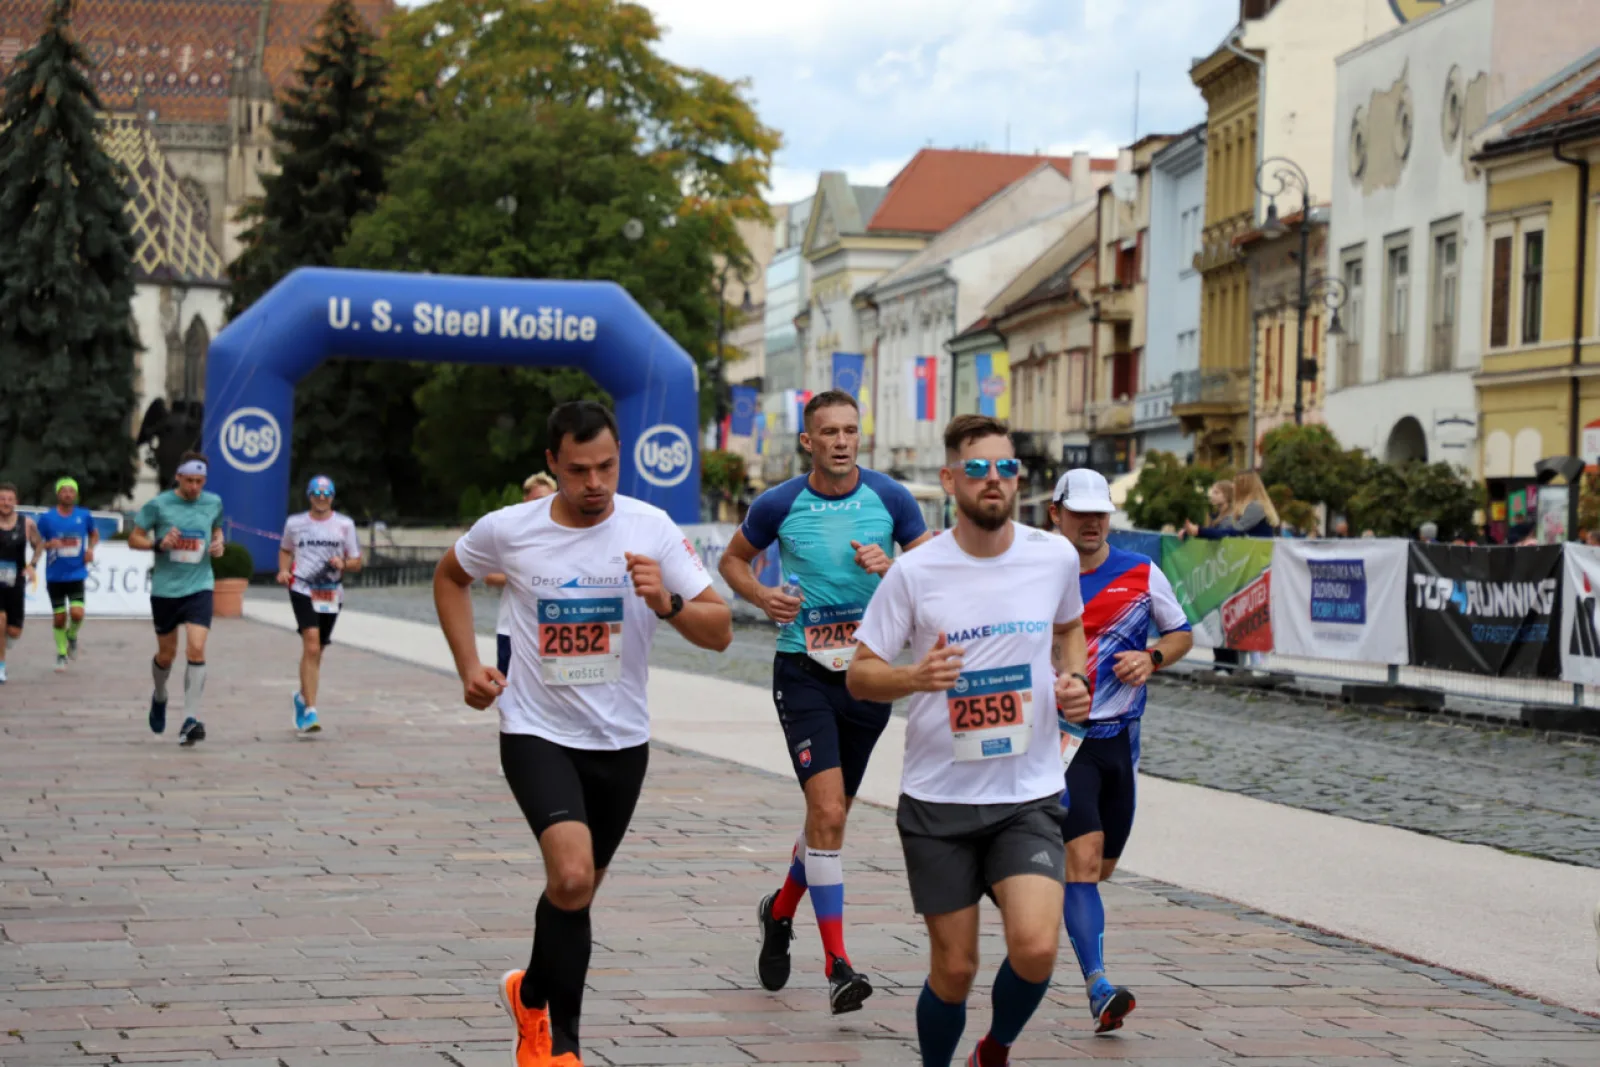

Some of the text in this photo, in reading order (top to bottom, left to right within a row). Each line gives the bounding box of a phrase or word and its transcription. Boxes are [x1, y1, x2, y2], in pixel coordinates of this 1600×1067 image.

[328, 296, 598, 343] U. S. Steel Košice
[544, 624, 605, 654] 2652
[946, 621, 1049, 644] MAKEHISTORY
[953, 693, 1017, 729] 2559
